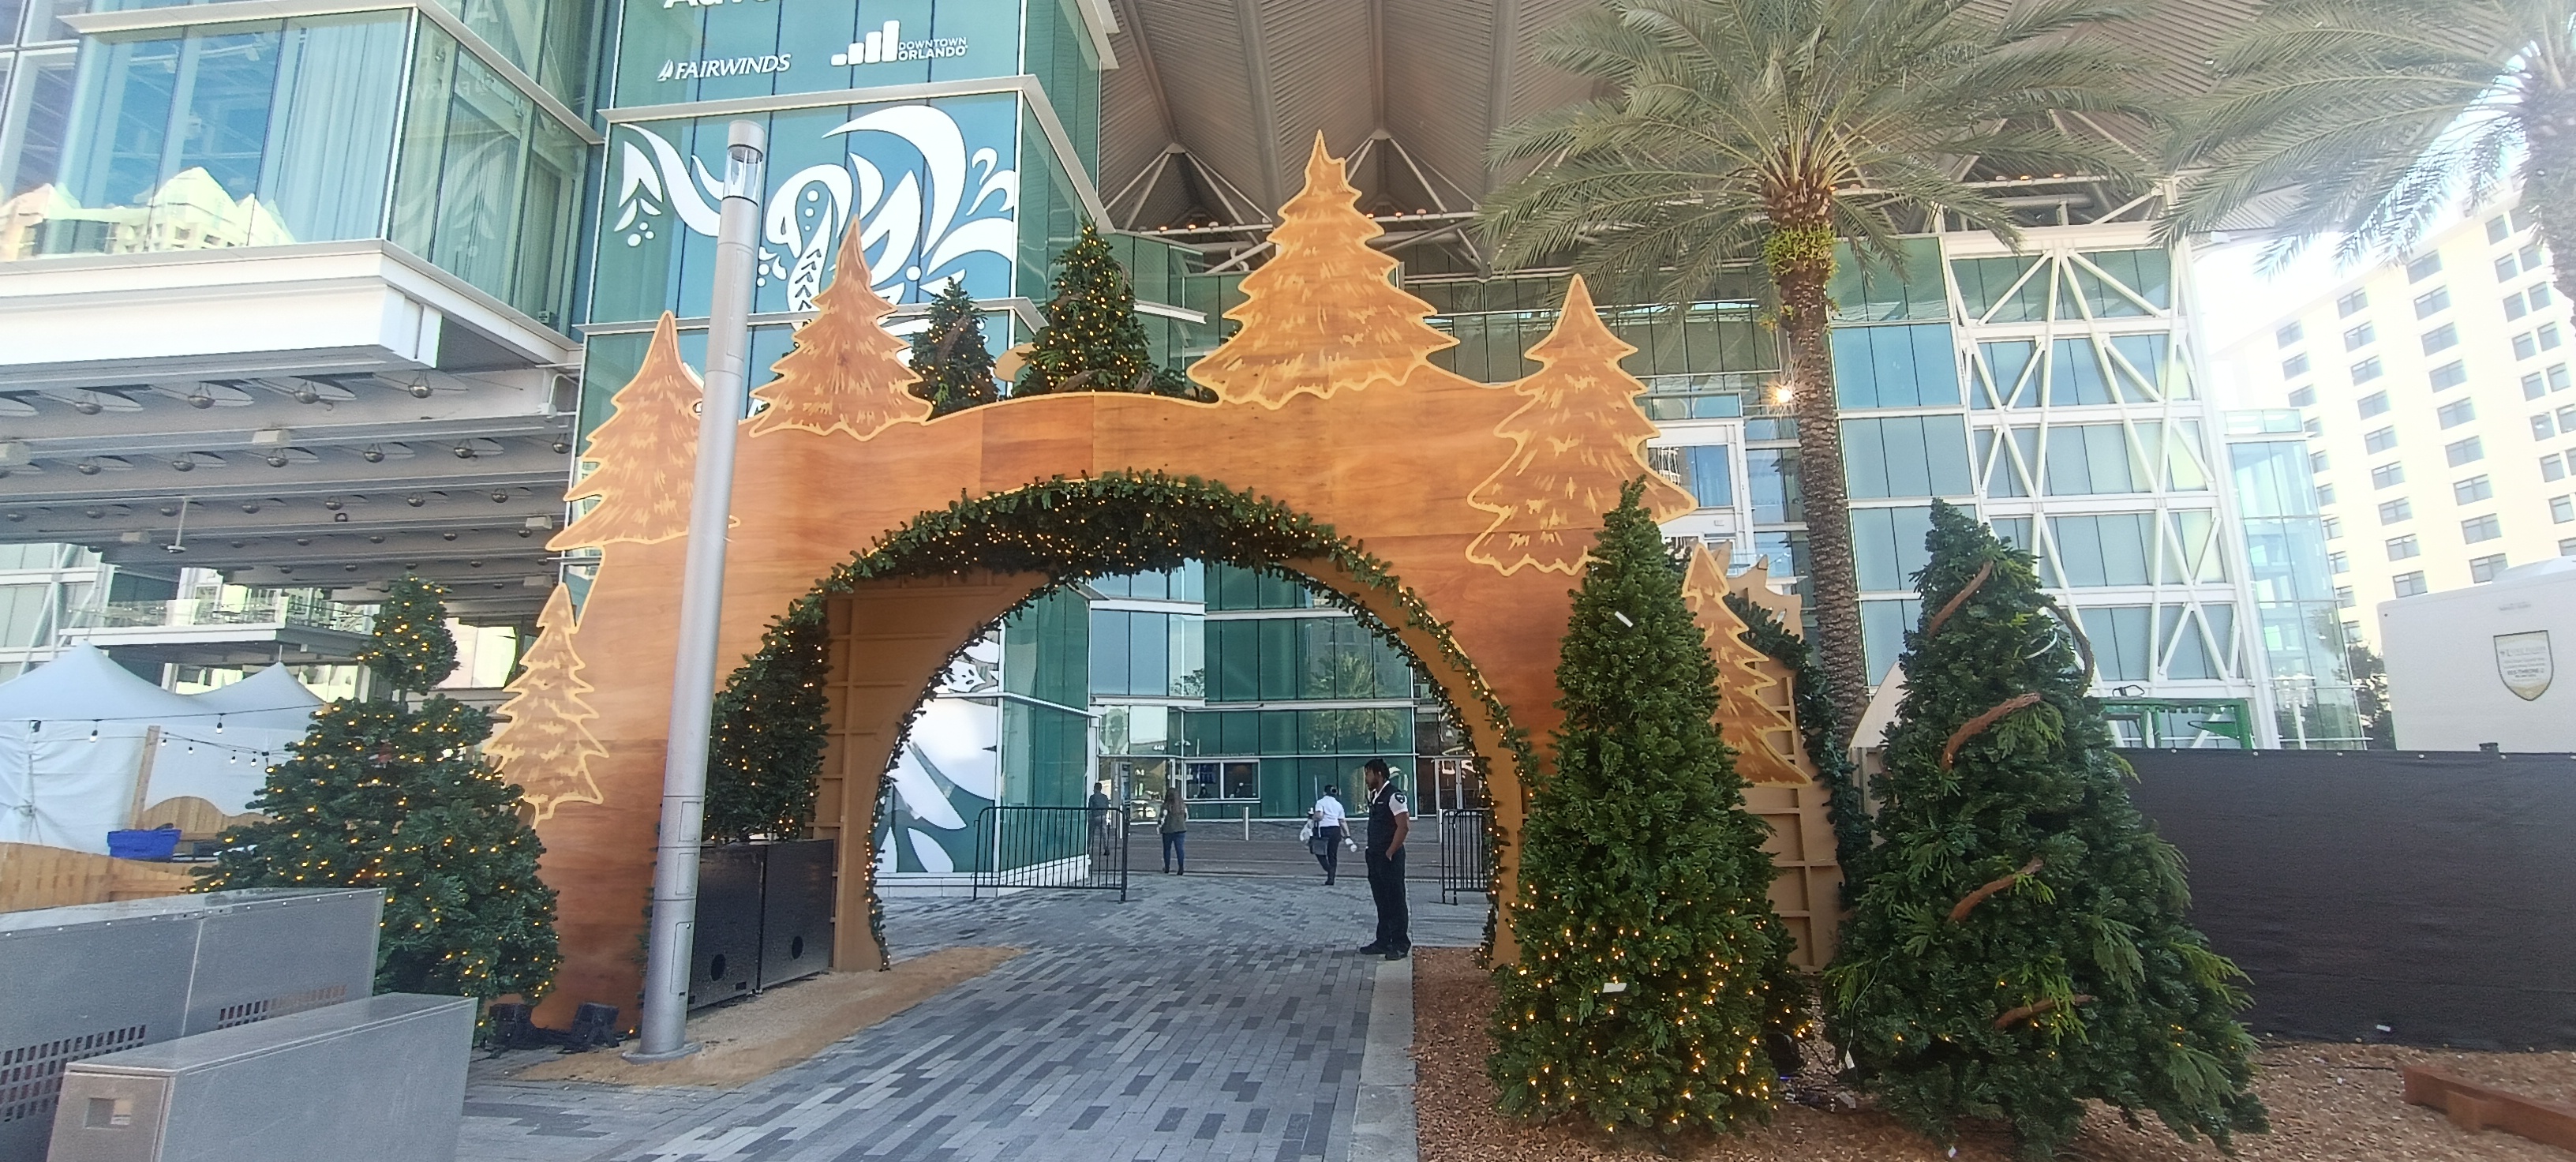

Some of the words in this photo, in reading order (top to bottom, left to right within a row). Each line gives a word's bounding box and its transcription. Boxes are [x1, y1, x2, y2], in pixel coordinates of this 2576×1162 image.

[898, 37, 967, 51] DOWNTOWN
[897, 45, 966, 61] ORLANDO
[675, 54, 792, 80] FAIRWINDS
